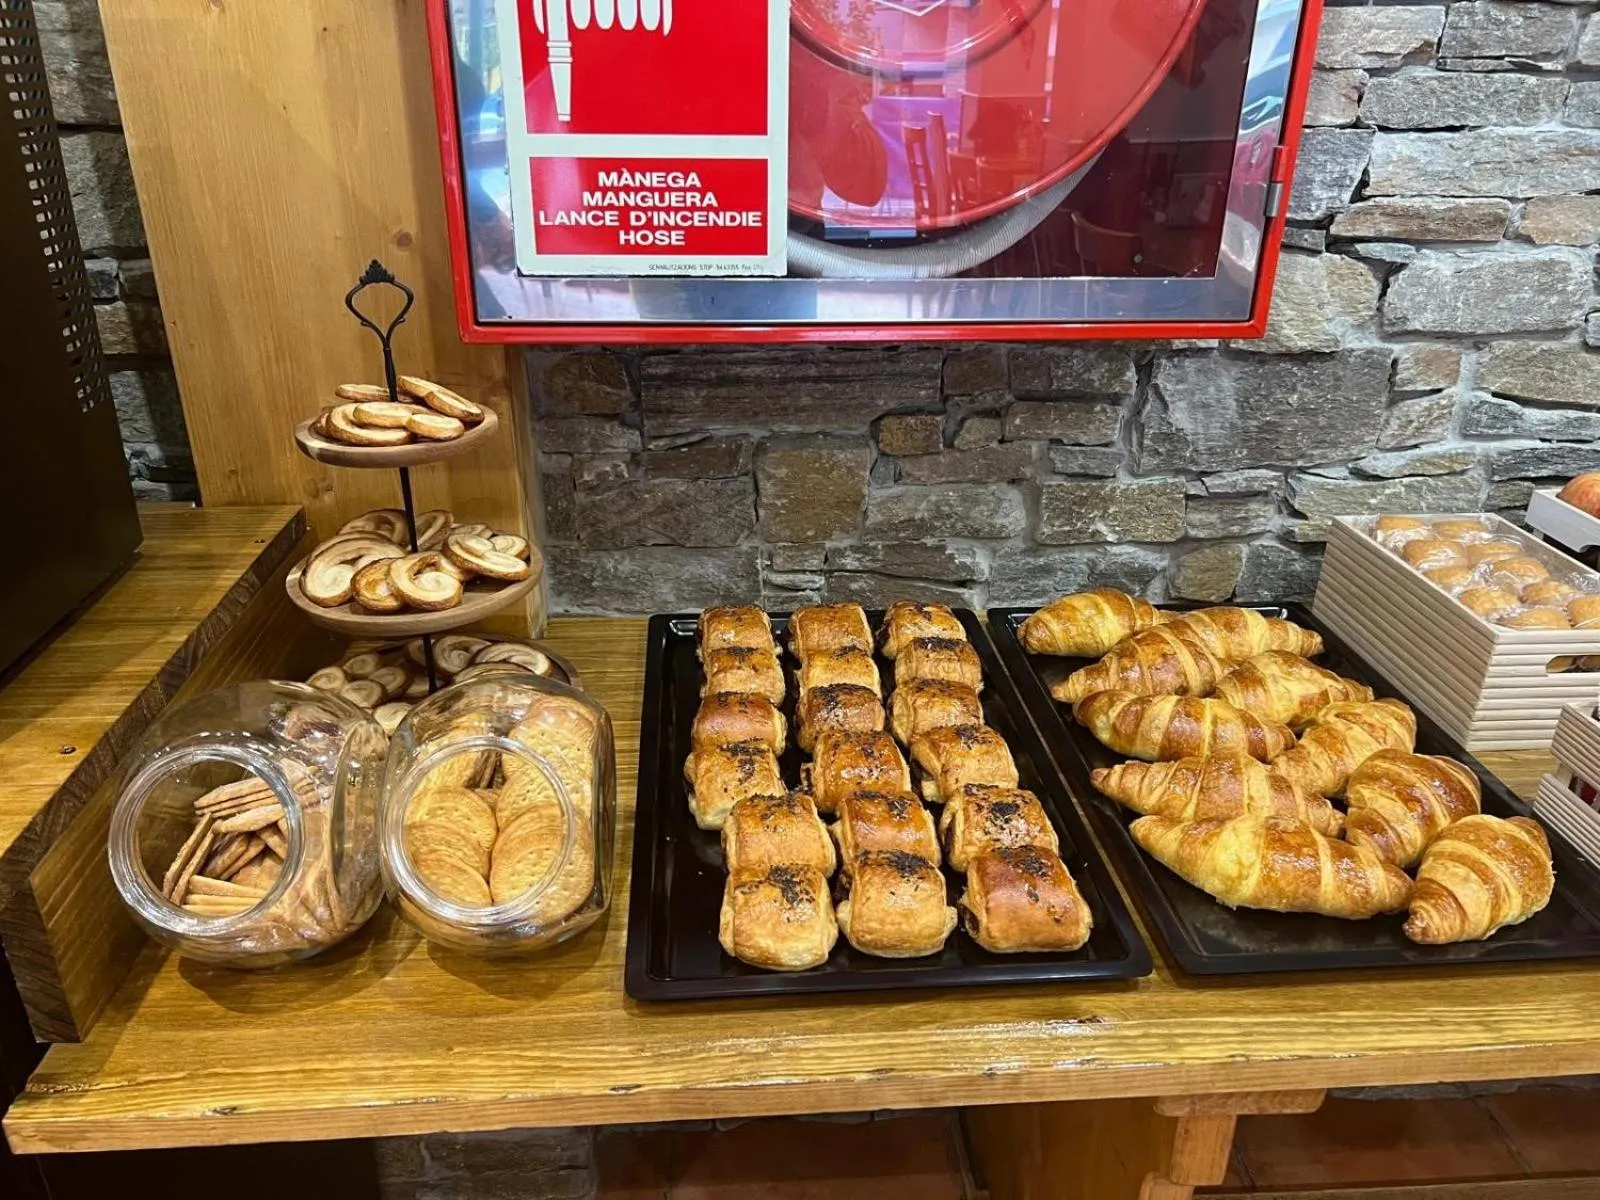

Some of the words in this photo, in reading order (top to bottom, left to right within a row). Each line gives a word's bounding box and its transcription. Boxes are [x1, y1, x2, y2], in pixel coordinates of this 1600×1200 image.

[598, 168, 701, 187] MÀNEGA
[583, 192, 718, 207] MANGUERA
[539, 211, 619, 226] LANCE
[630, 211, 761, 226] D'INCENDIE
[619, 230, 686, 245] HOSE
